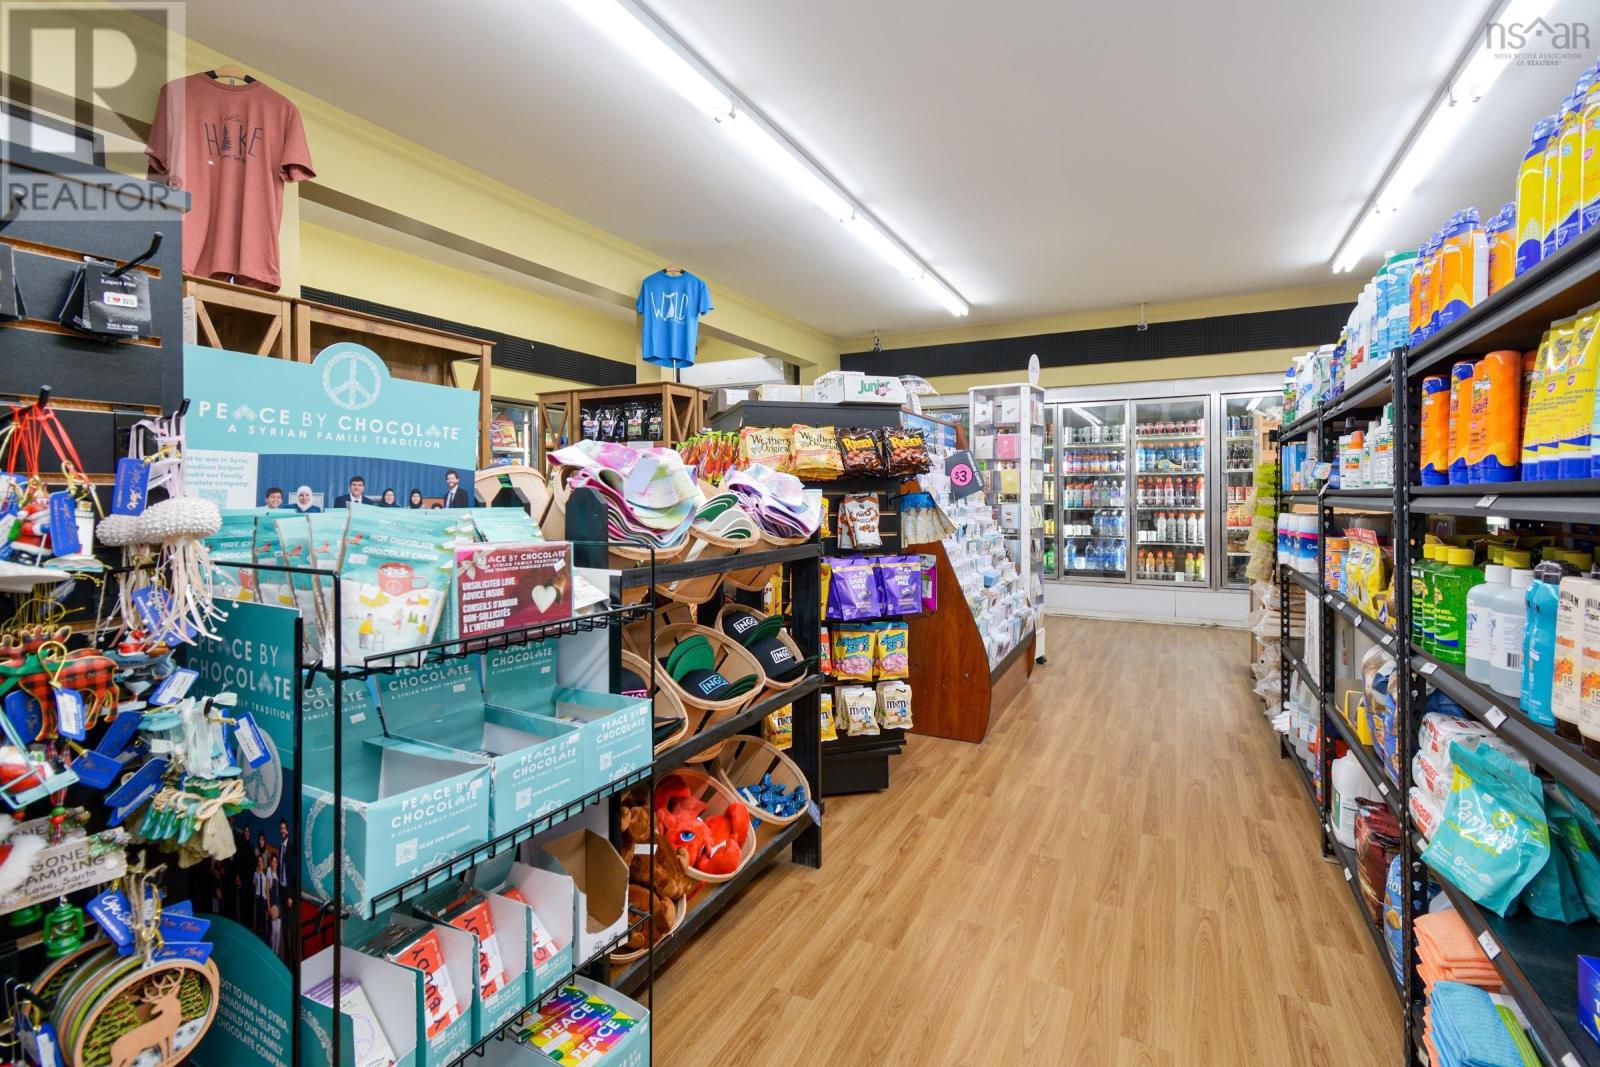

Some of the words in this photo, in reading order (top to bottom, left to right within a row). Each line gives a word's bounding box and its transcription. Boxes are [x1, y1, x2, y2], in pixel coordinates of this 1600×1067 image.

[198, 400, 291, 426] PEACE
[302, 411, 328, 429] BY
[338, 415, 461, 441] CHOCOLATE
[227, 423, 238, 434] A
[248, 425, 308, 440] SYRIAN
[316, 431, 368, 444] FAMILY
[375, 435, 441, 450] TRADITION
[954, 470, 967, 482] $3
[370, 533, 389, 543] HOT
[508, 554, 519, 562] BY
[520, 550, 566, 560] CHOCOLATE
[463, 590, 484, 601] ADVICE
[486, 587, 505, 599] INSIDE
[502, 576, 516, 587] LOVE
[463, 601, 493, 614] CONSEILS
[260, 643, 279, 667] BY
[491, 647, 553, 668] CHOCOLATE
[388, 664, 470, 691] CHOCOLATE
[596, 716, 645, 744] CHOCOLATE
[602, 713, 628, 732] PEACE
[512, 747, 577, 780] CHOCOLATE
[521, 744, 557, 767] PEACE
[391, 787, 478, 828] CHOCOLATE
[402, 786, 451, 812] PEACE
[31, 847, 87, 873] GONE
[24, 882, 57, 897] Love,
[63, 869, 97, 885] Santa
[232, 983, 243, 999] TO
[243, 991, 259, 1011] WAR
[259, 1001, 268, 1016] IN
[220, 991, 255, 1022] ANADIANS
[255, 1013, 281, 1040] HELPED
[542, 1003, 595, 1040] PEACE
[243, 1020, 259, 1040] OUR
[259, 1031, 284, 1056] FAMILY
[570, 1019, 621, 1060] PEACE
